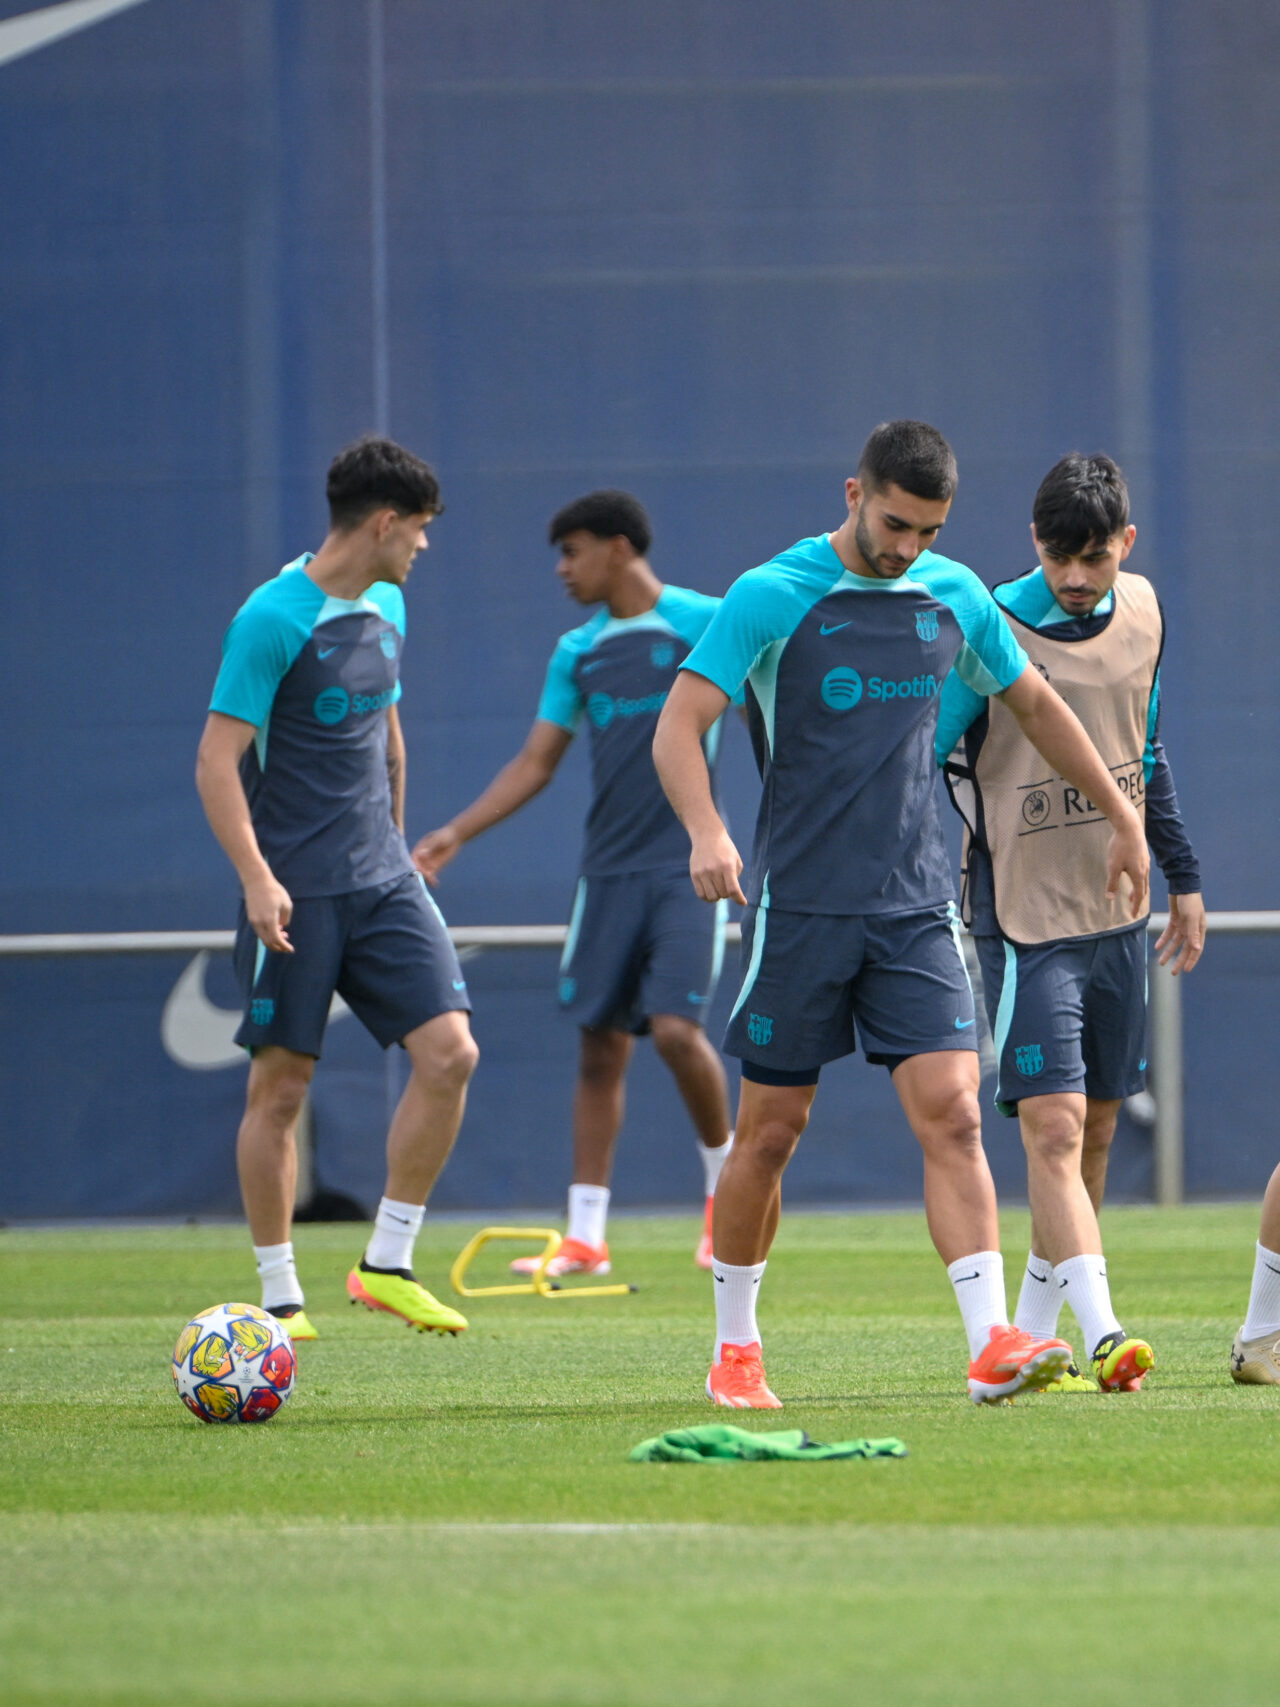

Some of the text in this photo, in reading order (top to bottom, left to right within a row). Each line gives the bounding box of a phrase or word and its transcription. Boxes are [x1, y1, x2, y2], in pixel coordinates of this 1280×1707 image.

[351, 689, 395, 716] Spot
[867, 674, 942, 703] Spotify
[1063, 770, 1144, 816] RPEC
